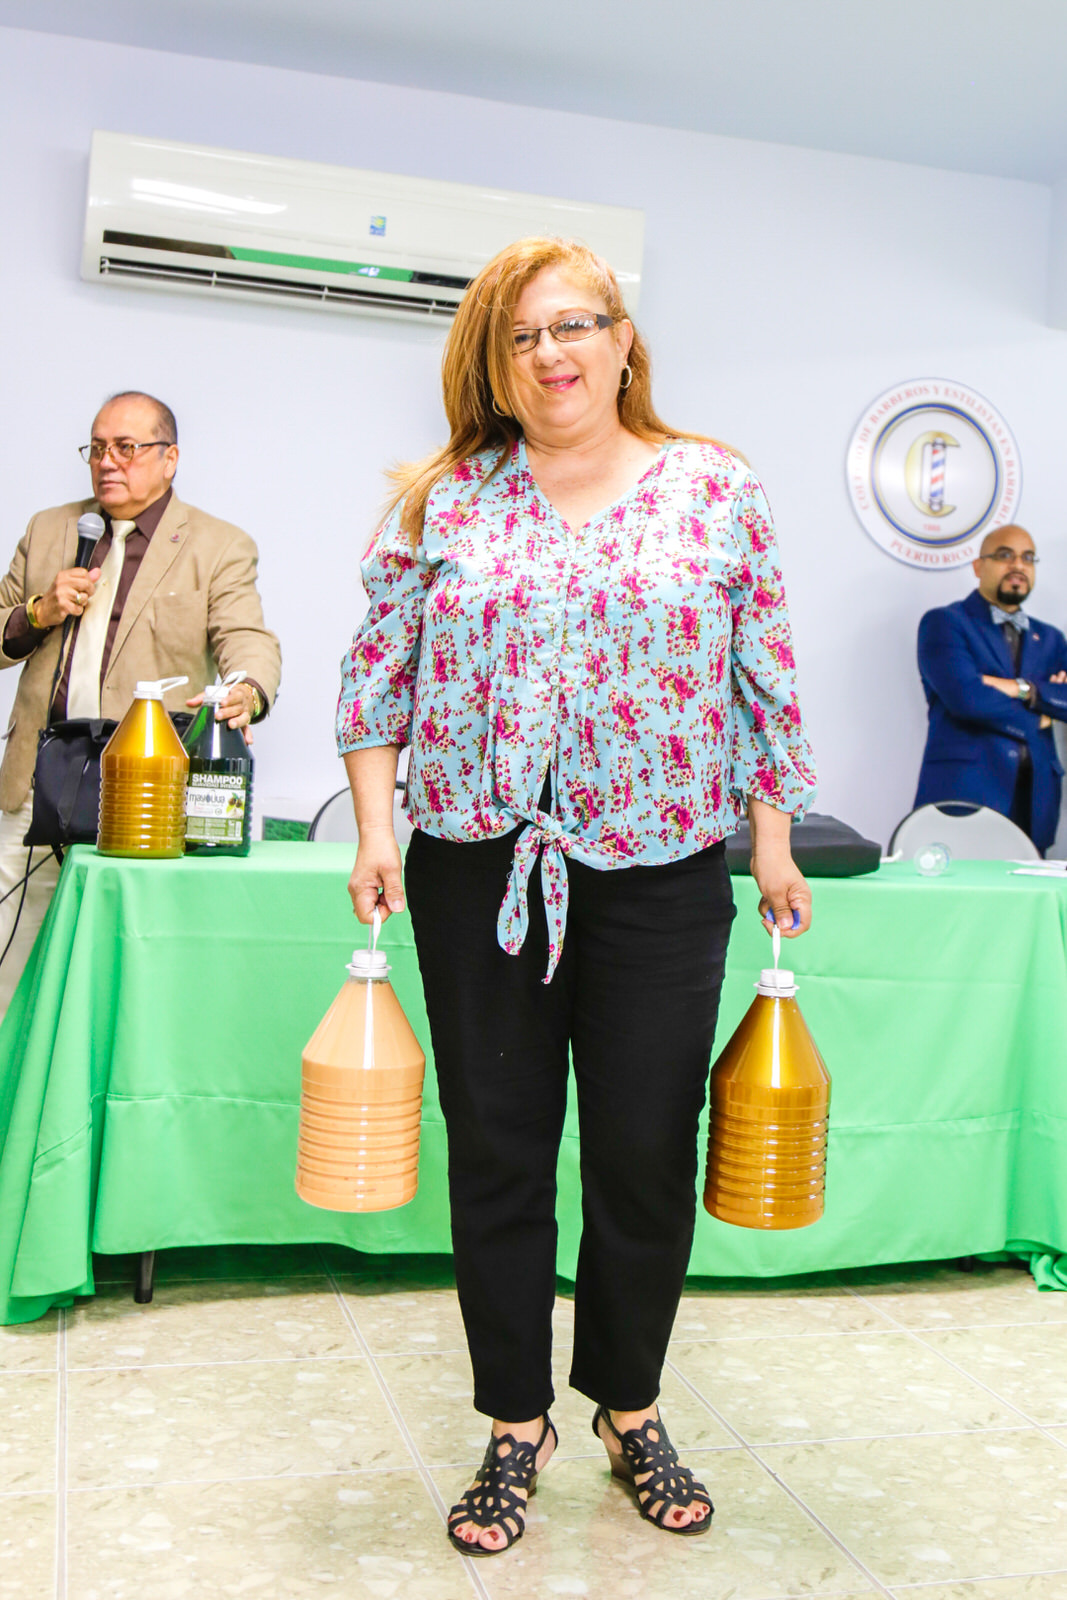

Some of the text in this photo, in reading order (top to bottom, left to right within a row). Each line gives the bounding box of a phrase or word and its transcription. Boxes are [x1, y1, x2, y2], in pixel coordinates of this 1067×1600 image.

[858, 427, 873, 444] DE
[869, 385, 931, 425] BARBEROS
[933, 385, 942, 396] Y
[943, 386, 1007, 440] ESTILISTAS
[890, 539, 974, 563] PUERTO RICO
[192, 773, 243, 785] SHAMPOO
